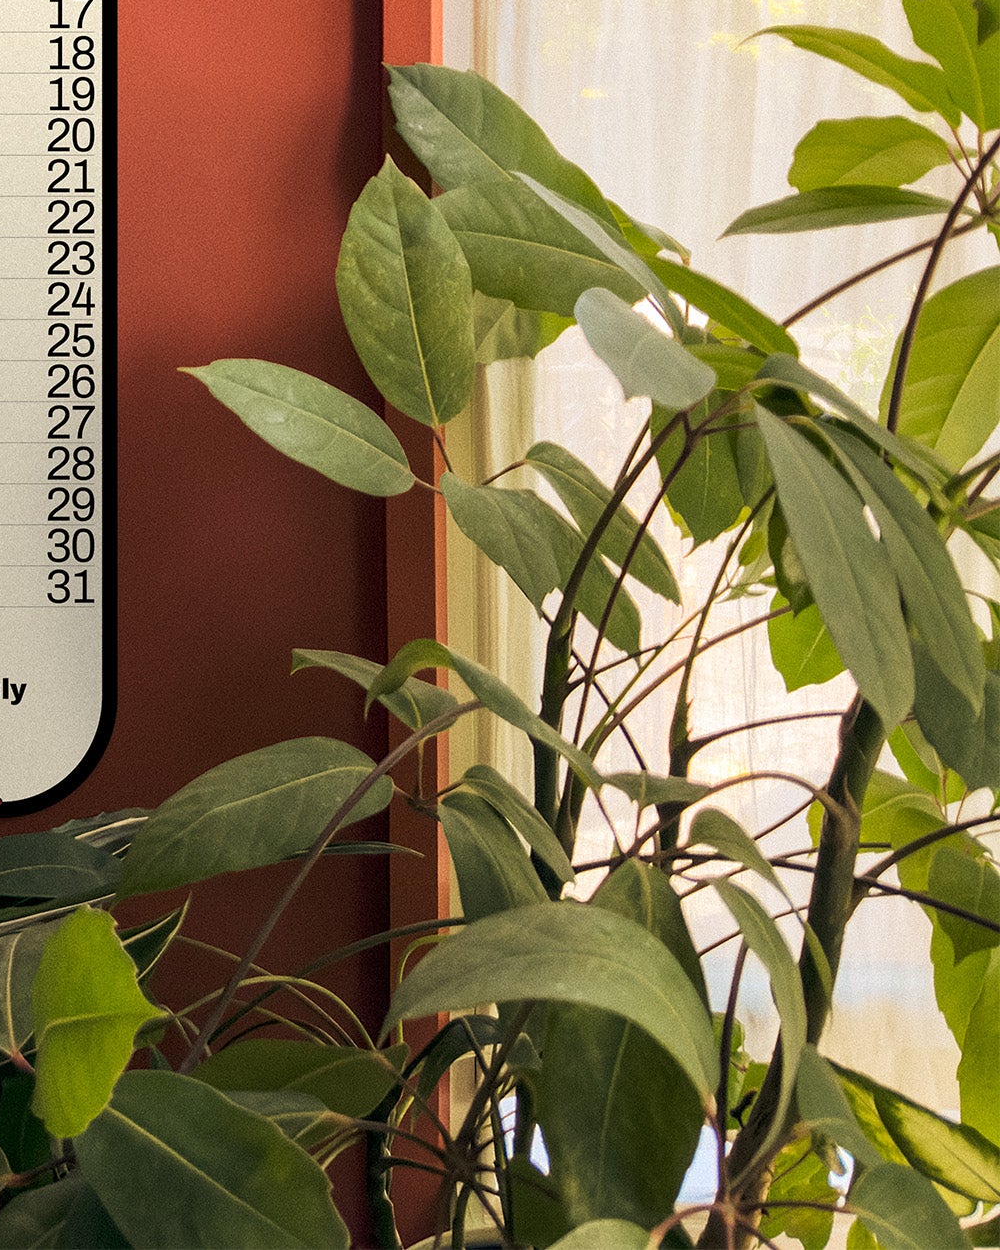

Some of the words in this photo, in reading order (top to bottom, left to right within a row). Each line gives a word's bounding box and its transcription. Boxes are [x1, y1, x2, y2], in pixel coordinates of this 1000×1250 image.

[50, 36, 94, 70] 18
[50, 77, 94, 111] 19
[48, 118, 94, 152] 20
[48, 159, 94, 192] 21
[48, 200, 94, 233] 22
[48, 241, 95, 275] 23
[48, 282, 95, 315] 24
[48, 323, 94, 357] 25
[48, 364, 95, 398] 26
[48, 405, 95, 439] 27
[48, 446, 94, 480] 28
[48, 487, 94, 521] 29
[48, 528, 94, 562] 30
[48, 569, 94, 603] 31
